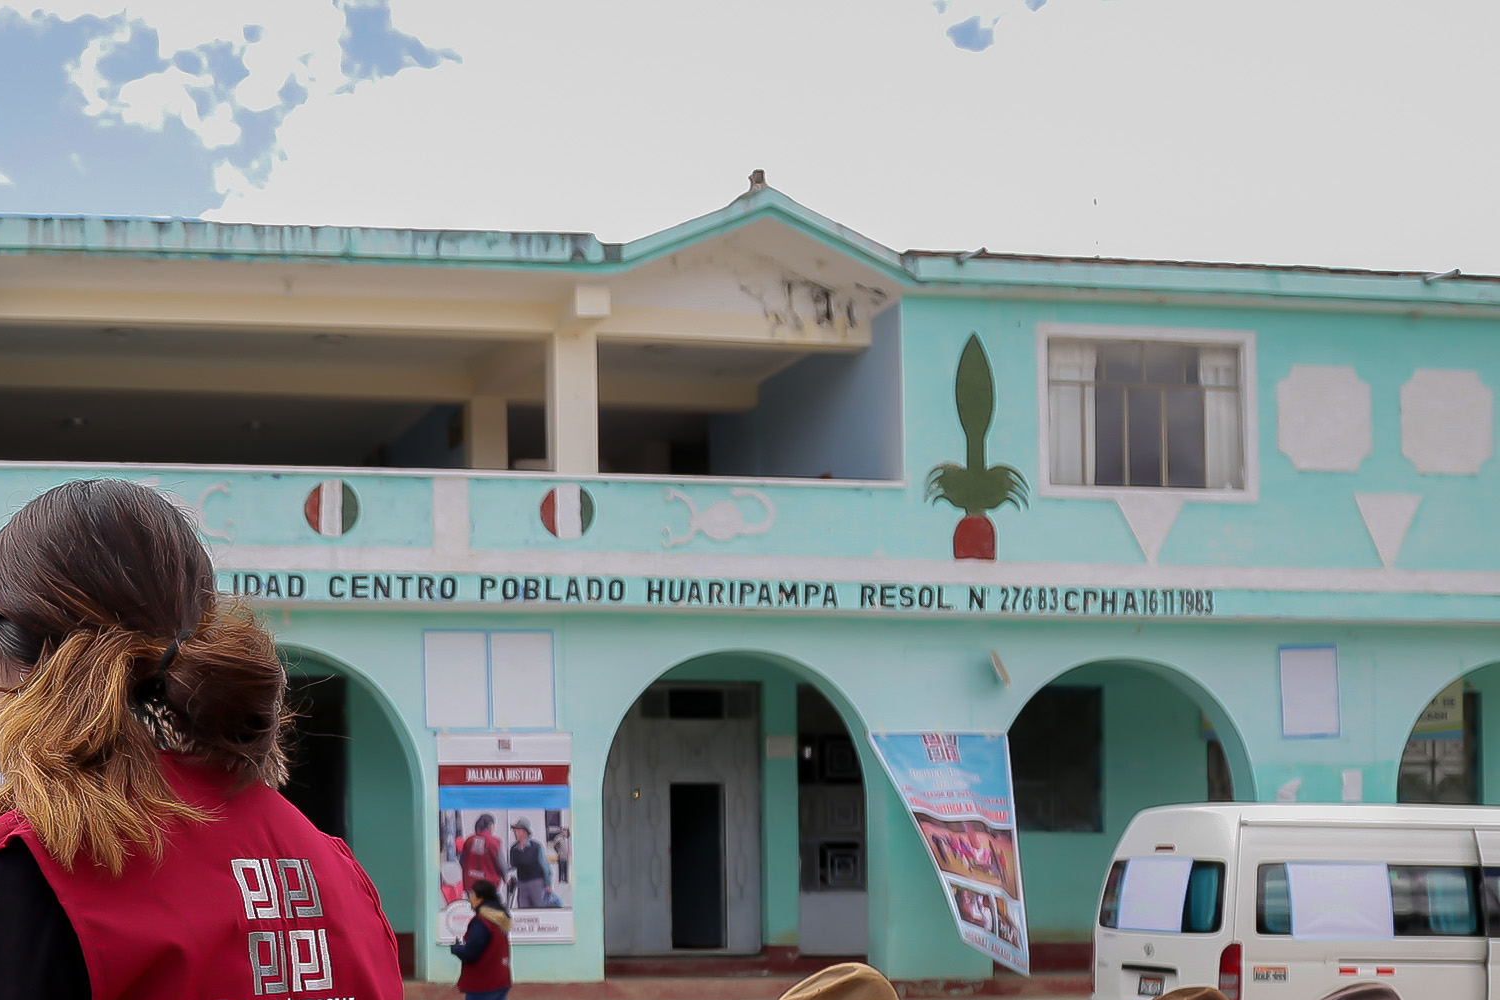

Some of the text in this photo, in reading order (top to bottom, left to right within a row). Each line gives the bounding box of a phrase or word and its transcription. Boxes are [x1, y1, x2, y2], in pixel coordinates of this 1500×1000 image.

[328, 574, 457, 601] CENTRO
[478, 575, 627, 602] POBLADO
[646, 578, 839, 608] HUARIPAMPA
